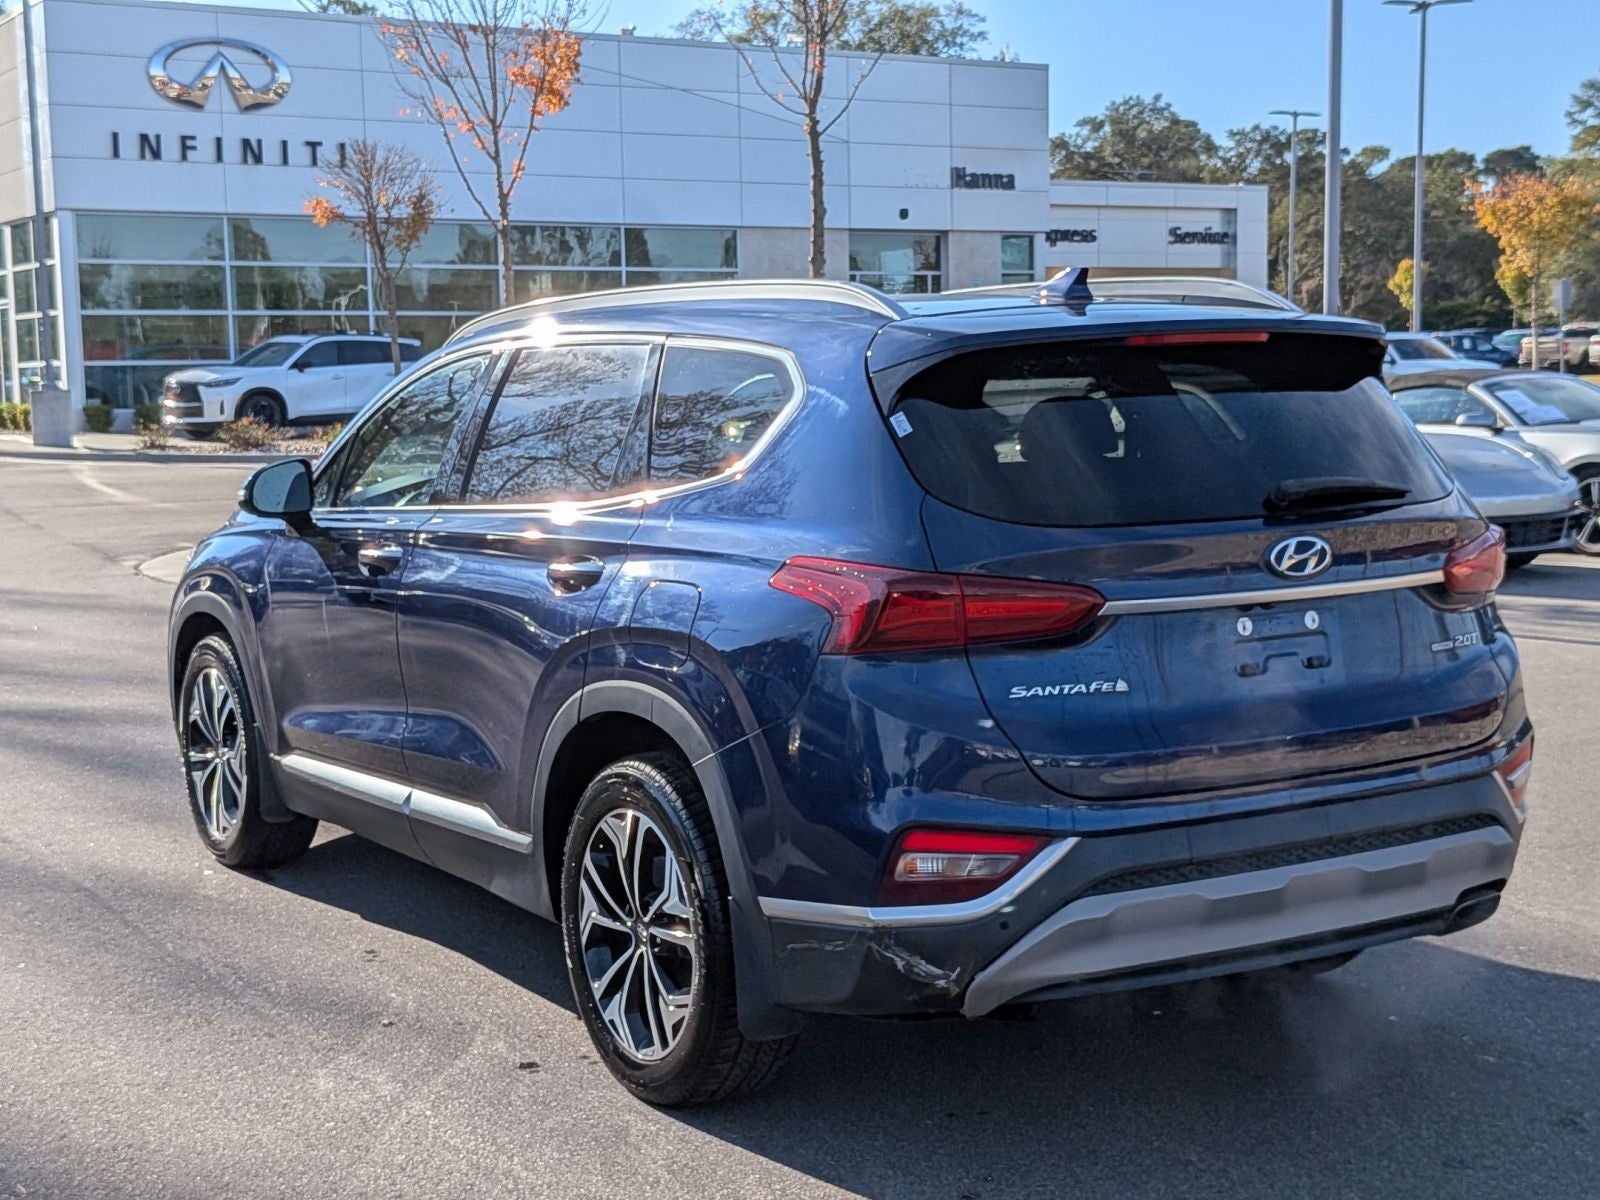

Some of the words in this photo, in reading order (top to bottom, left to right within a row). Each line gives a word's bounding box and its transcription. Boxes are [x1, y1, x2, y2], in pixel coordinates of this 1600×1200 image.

[111, 131, 346, 168] INFINITI
[951, 166, 1015, 191] Hanna
[1045, 229, 1097, 247] xpress
[1167, 226, 1230, 245] Service
